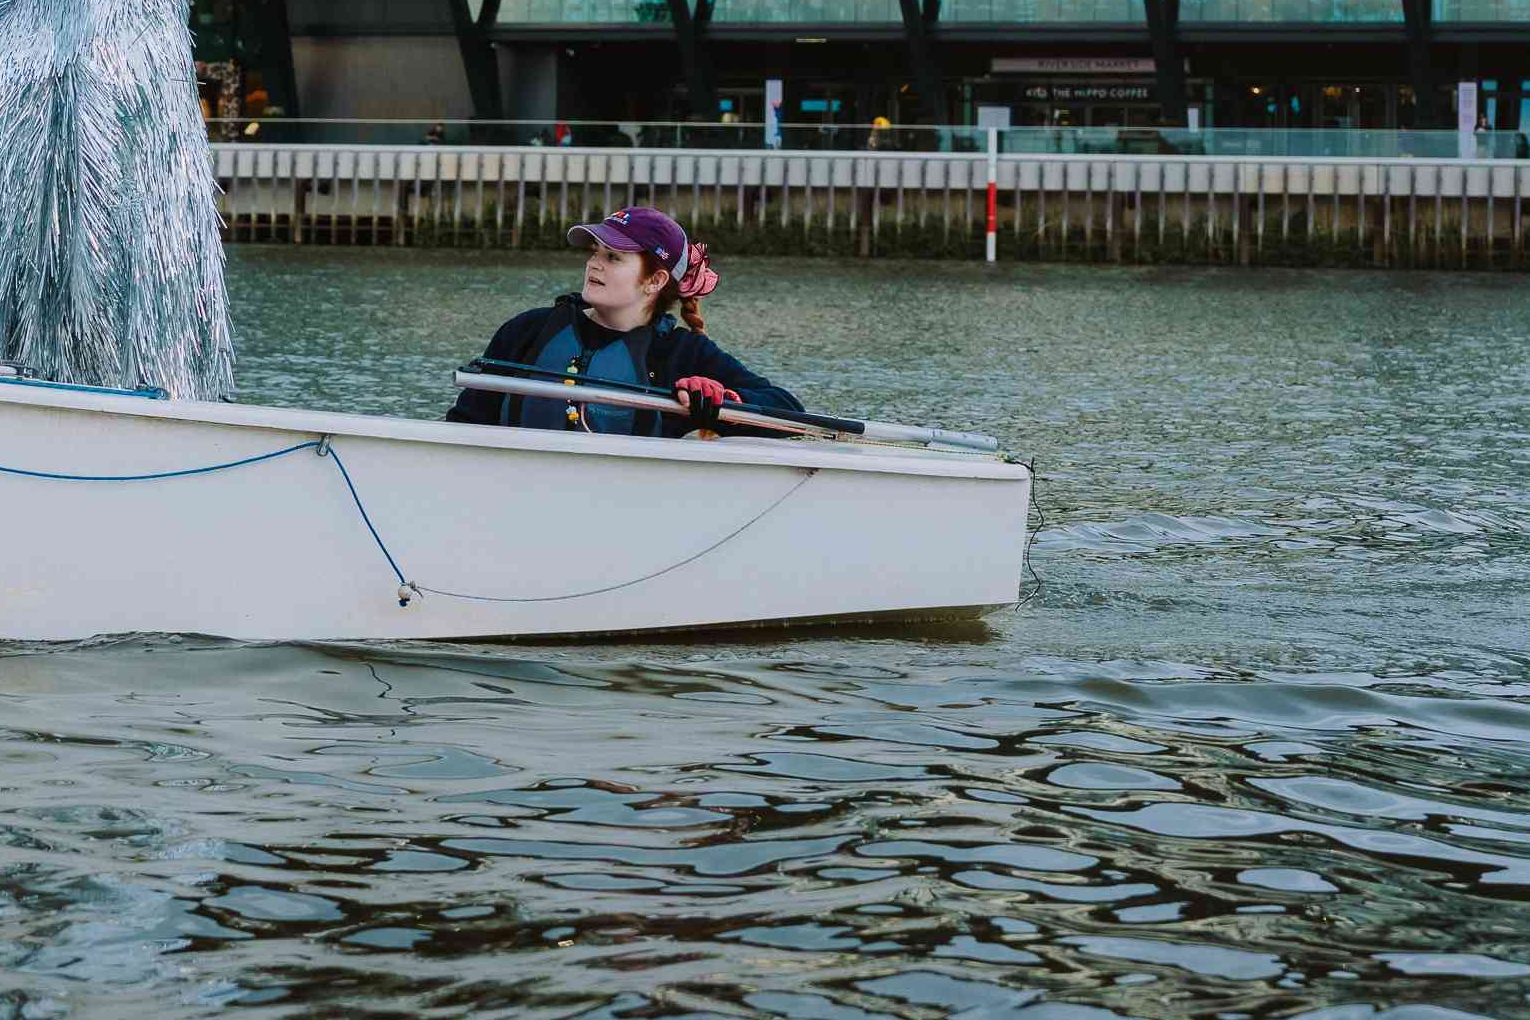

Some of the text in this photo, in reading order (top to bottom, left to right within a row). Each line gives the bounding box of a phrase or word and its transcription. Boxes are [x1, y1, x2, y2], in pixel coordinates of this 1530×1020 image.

[1095, 59, 1139, 69] MARKET
[1052, 87, 1070, 98] THE
[1110, 87, 1149, 98] COFFEE
